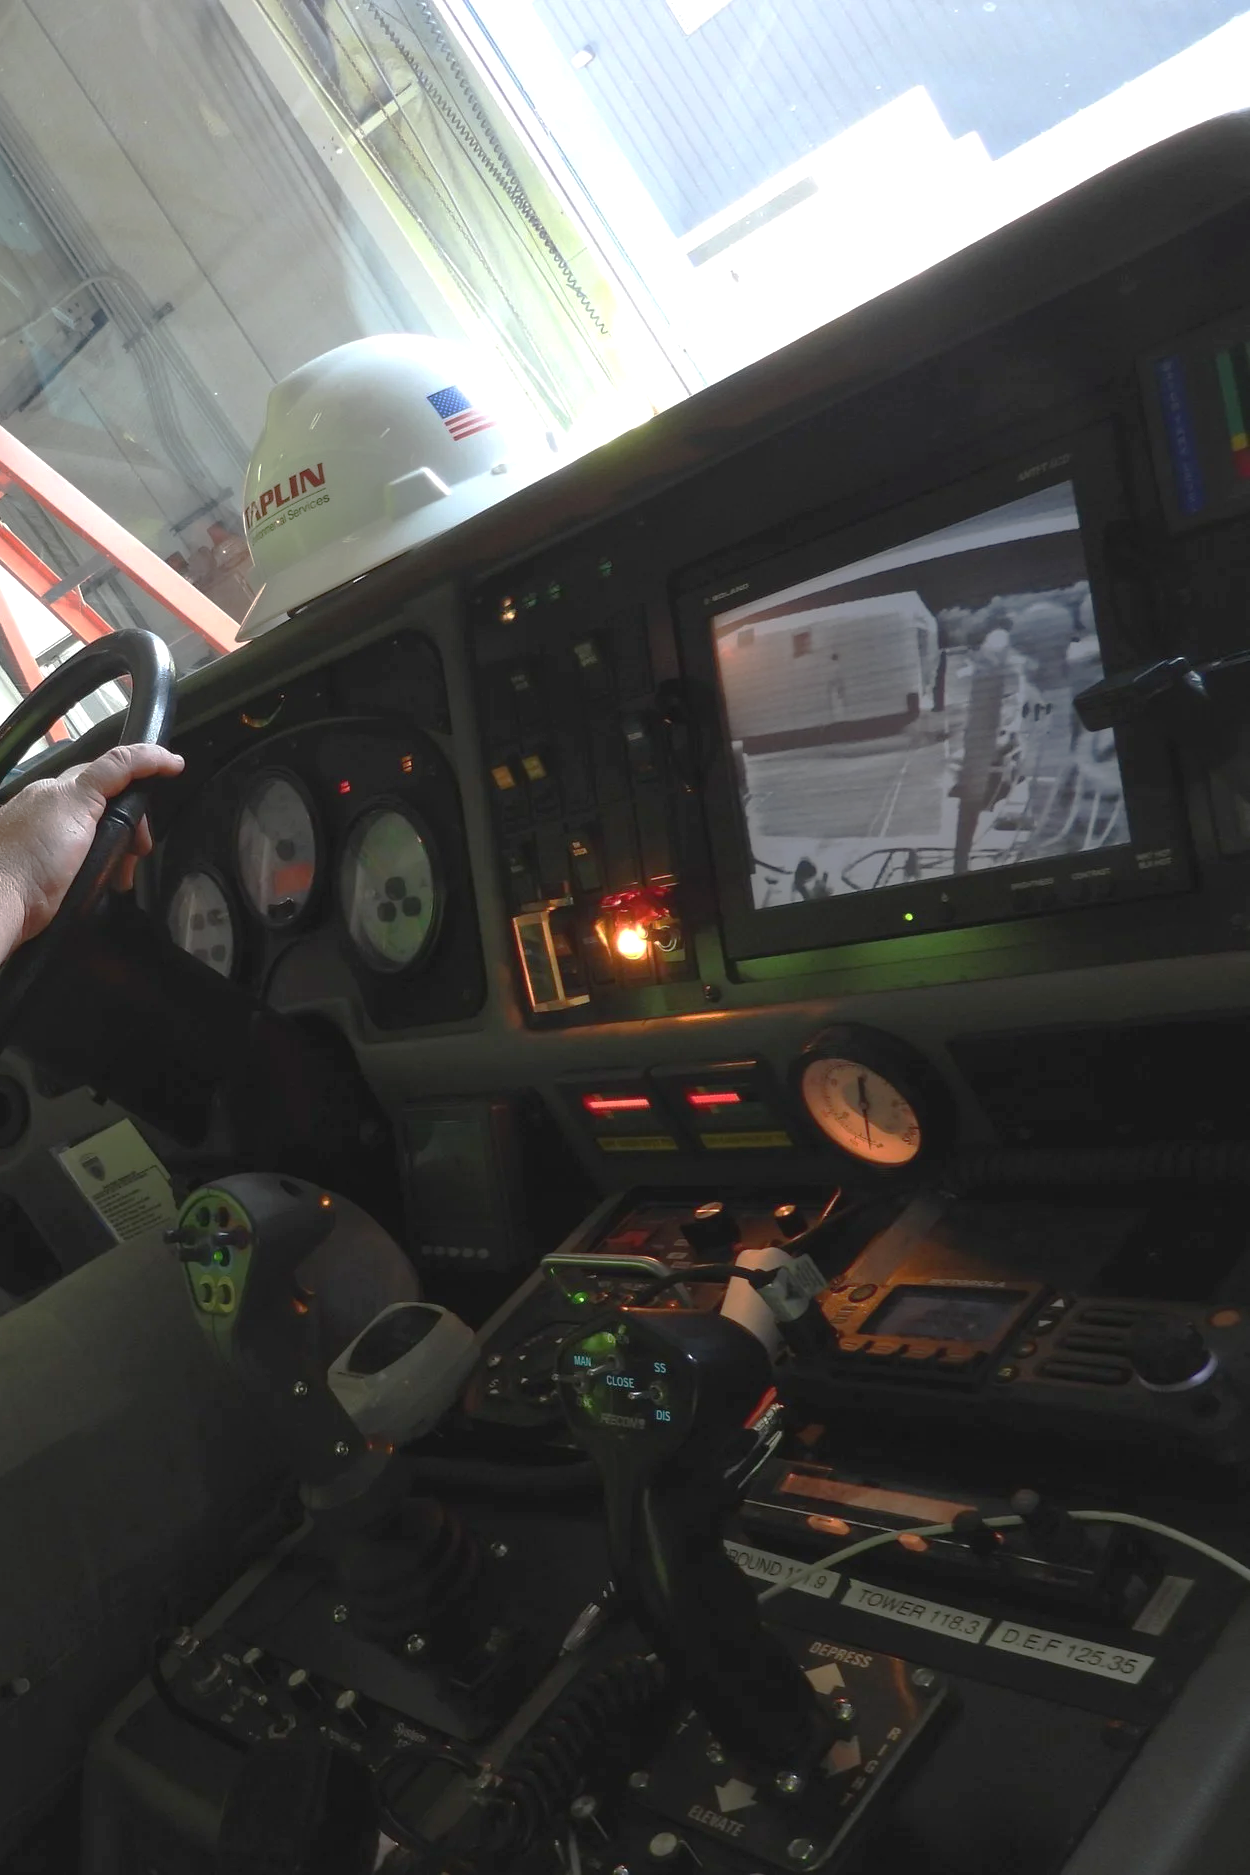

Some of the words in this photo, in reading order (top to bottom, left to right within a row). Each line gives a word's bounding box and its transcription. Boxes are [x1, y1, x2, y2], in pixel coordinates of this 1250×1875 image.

[287, 494, 330, 521] Services
[573, 1355, 592, 1367] MAN
[654, 1362, 667, 1374] SS
[606, 1375, 635, 1389] CLOSE
[656, 1409, 671, 1422] DIS
[726, 1548, 782, 1576] ROUND
[858, 1588, 927, 1620] TOWER
[930, 1610, 980, 1635] 118.3
[808, 1641, 873, 1668] DEPRESS
[1001, 1628, 1062, 1653] D.E.F
[1065, 1643, 1139, 1674] 125.35
[839, 1726, 902, 1807] RIGHT
[687, 1804, 747, 1837] ELEVATE
